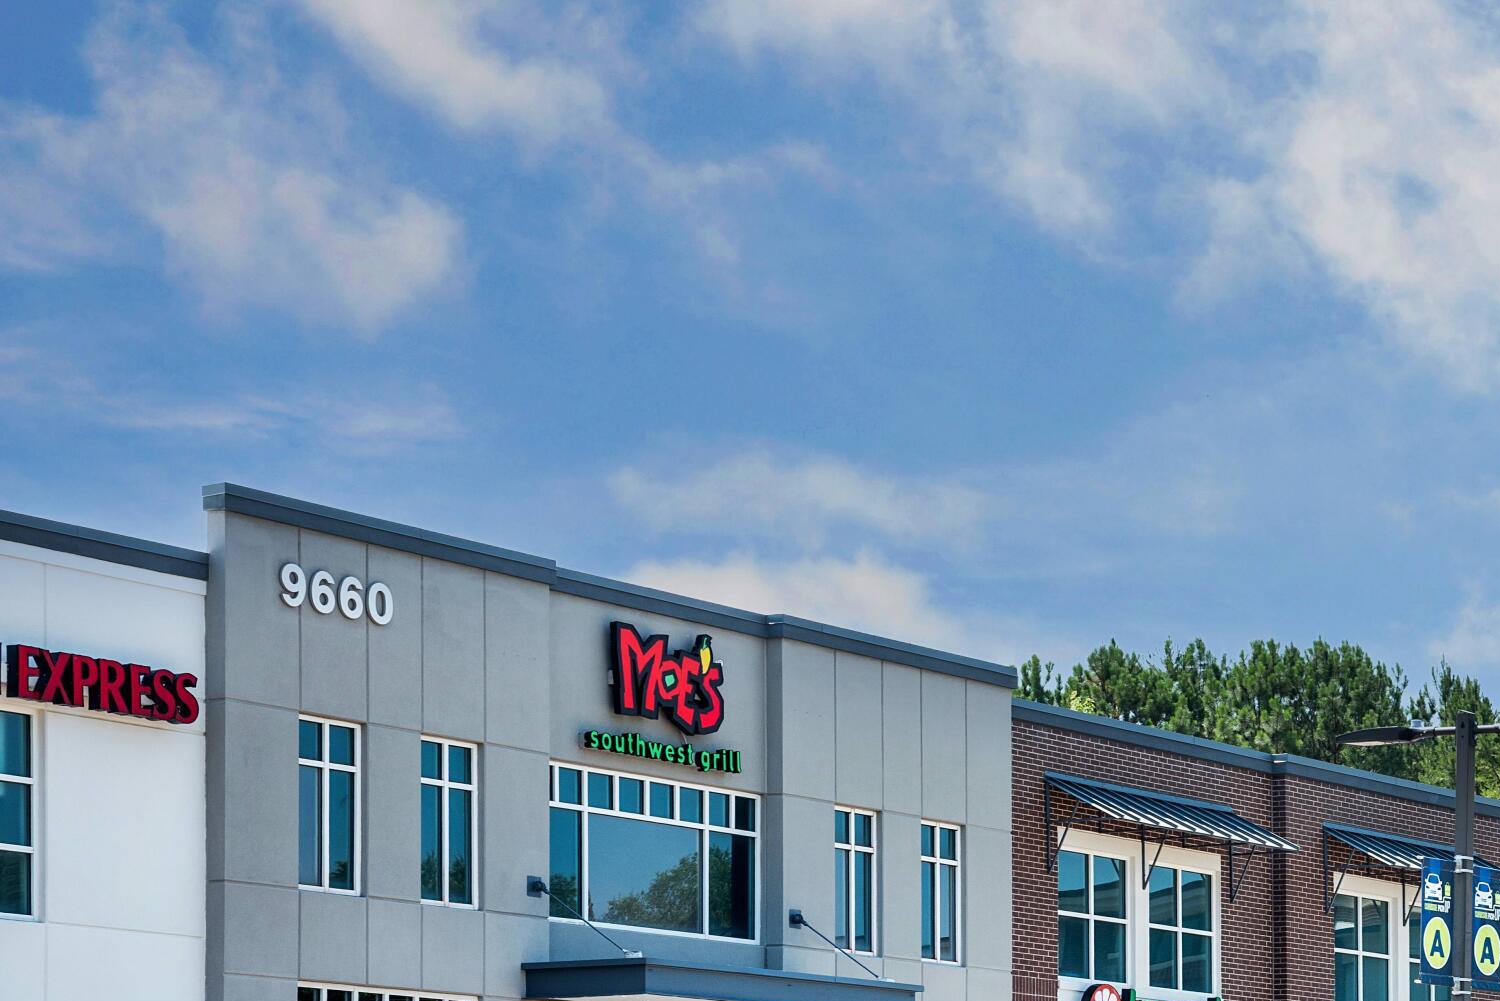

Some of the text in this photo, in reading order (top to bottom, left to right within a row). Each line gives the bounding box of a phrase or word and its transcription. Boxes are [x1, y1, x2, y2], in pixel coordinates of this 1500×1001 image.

[281, 563, 393, 625] 9660
[11, 644, 199, 724] EXPRESS
[588, 731, 742, 773] southwest grill
[1430, 930, 1444, 957] A
[1480, 937, 1494, 964] A
